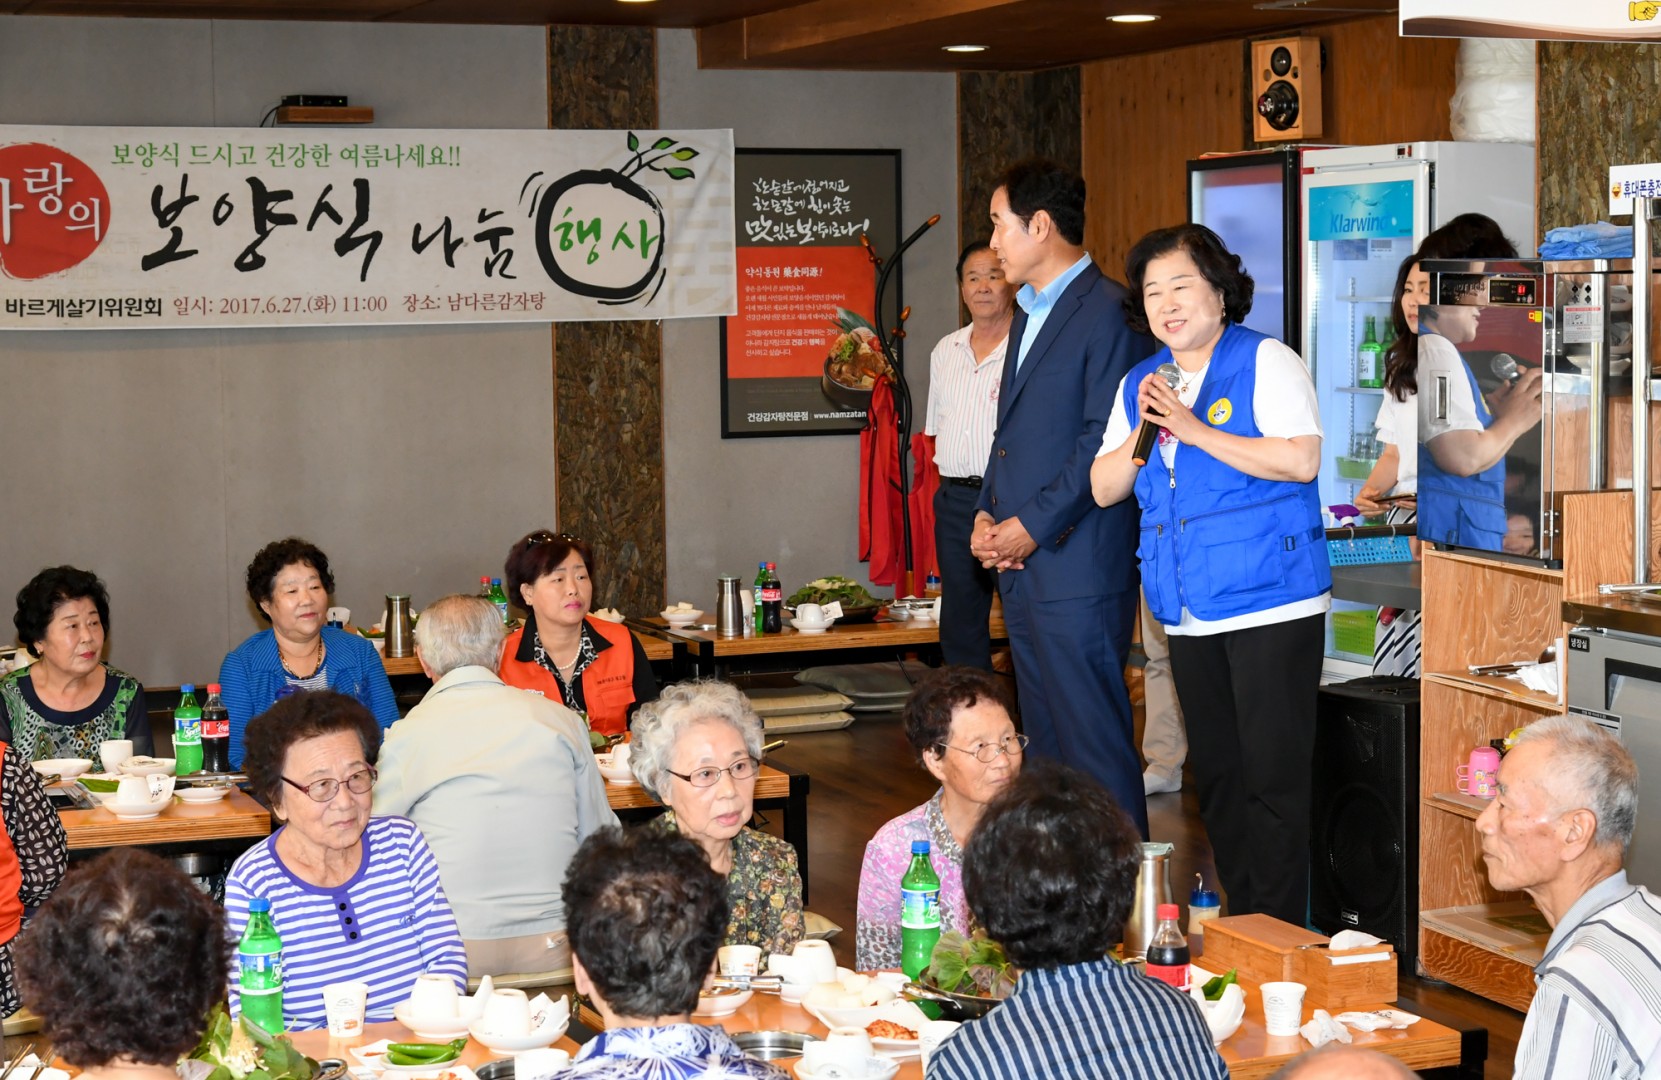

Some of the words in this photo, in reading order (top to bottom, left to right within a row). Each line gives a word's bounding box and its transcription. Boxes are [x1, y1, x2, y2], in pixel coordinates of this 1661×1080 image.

[111, 142, 180, 168] 보양식
[188, 142, 257, 168] 드시고
[265, 142, 333, 168] 건강한
[340, 142, 461, 168] 여름나세요!!
[141, 173, 383, 282] 보양식
[411, 207, 517, 280] 나눔
[553, 206, 658, 265] 행사
[745, 214, 797, 242] 맛있는
[5, 297, 162, 318] 바르게살기위원회
[173, 295, 214, 317] 일시:
[219, 294, 337, 316] 2017.6.27.(화)
[343, 296, 388, 313] 11:00
[402, 295, 440, 313] 장소:
[447, 291, 547, 312] 남다른감자탕
[747, 411, 809, 423] 건강감자탕전문점
